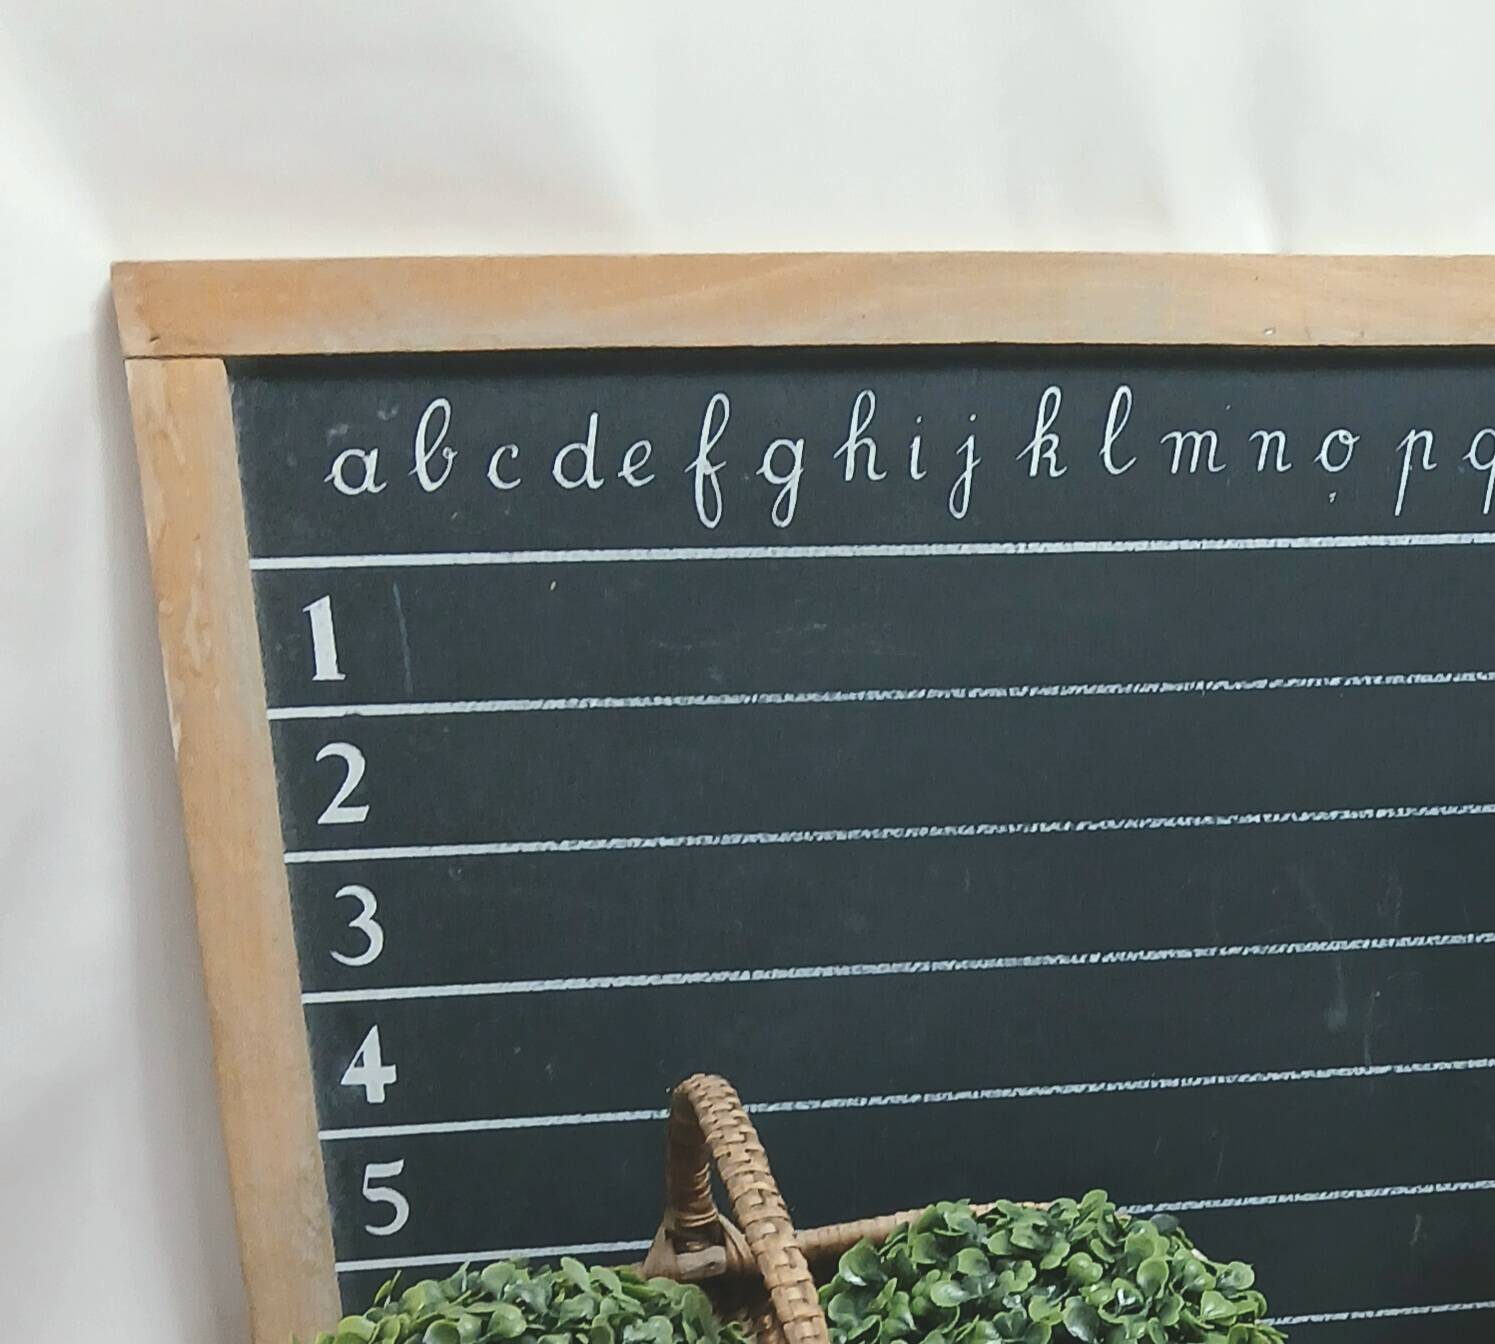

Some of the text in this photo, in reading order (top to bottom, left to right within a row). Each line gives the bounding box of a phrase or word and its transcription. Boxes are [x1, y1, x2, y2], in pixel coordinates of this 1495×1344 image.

[324, 449, 387, 496] a
[409, 398, 458, 493] b
[486, 443, 522, 490] c
[552, 411, 605, 491] d
[617, 439, 656, 488] e
[684, 393, 730, 529] f
[756, 437, 805, 528] g
[833, 389, 888, 483] h
[906, 413, 928, 481] i
[947, 412, 982, 519] j
[1016, 385, 1068, 478] k
[1099, 385, 1137, 476] l
[1160, 430, 1226, 474] m
[1248, 430, 1292, 473] n
[1314, 429, 1360, 474] o
[1395, 429, 1438, 517] p
[302, 595, 346, 681] 1
[315, 742, 370, 825] 2
[330, 884, 384, 966] 3
[340, 1024, 397, 1104] 4
[362, 1159, 410, 1237] 5
